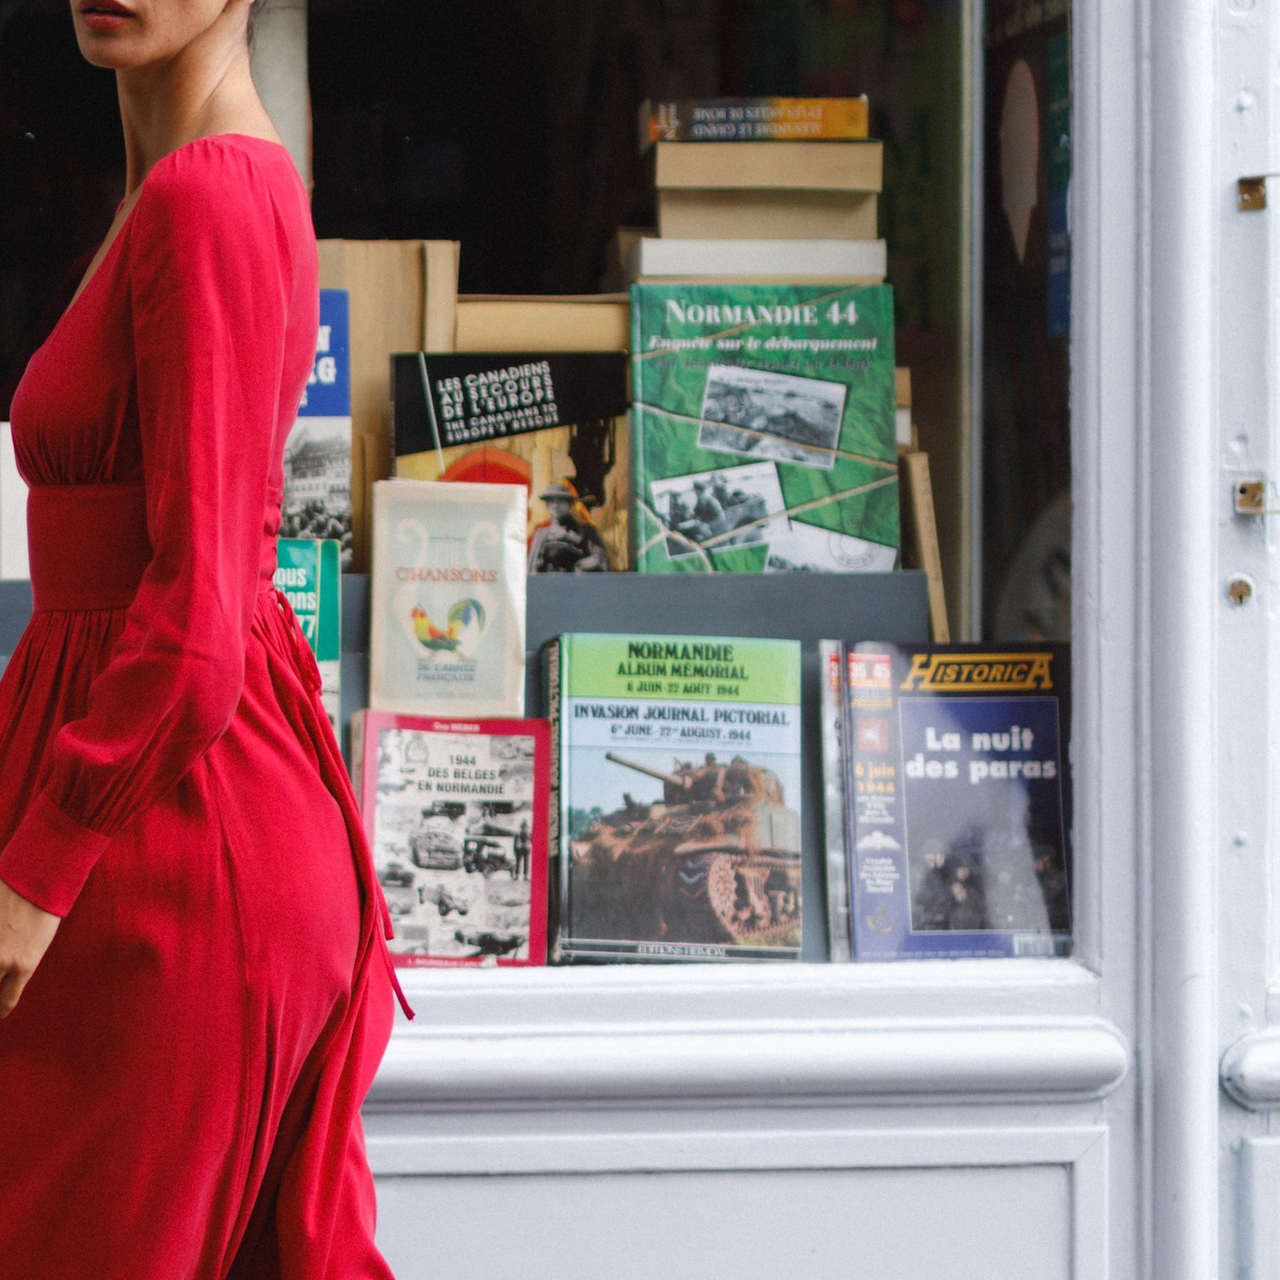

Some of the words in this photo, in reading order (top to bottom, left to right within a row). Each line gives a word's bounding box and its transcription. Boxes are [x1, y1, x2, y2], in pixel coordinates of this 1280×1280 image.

[665, 299, 818, 325] NORMANDIE
[825, 300, 859, 326] 44
[648, 335, 713, 352] Enquête
[717, 337, 743, 351] sur
[746, 336, 761, 350] le
[764, 335, 878, 355] débarquement
[438, 377, 461, 393] LES
[465, 360, 551, 387] CANADIENS
[440, 389, 464, 406] AU
[469, 373, 553, 401] SECOURS
[443, 404, 464, 420] DE
[471, 388, 555, 415] L'EUROPE
[444, 421, 465, 432] THE
[470, 407, 541, 427] CANADIANS
[542, 403, 558, 415] TO
[513, 413, 559, 431] RESCUE
[396, 565, 498, 584] CHANSONS
[628, 641, 734, 662] NORMANDIE
[617, 661, 667, 676] ALBUM
[899, 652, 1054, 692] HISTORICA
[637, 680, 662, 692] JUIN
[716, 684, 740, 696] 1944
[574, 703, 639, 719] INVASION
[643, 705, 709, 722] JOURNAL
[714, 707, 791, 725] PICTORIAL
[624, 724, 653, 736] JUNE
[728, 729, 752, 741] 1944
[925, 725, 961, 751] La
[972, 724, 1034, 752] nuit
[449, 754, 476, 766] 1944
[867, 761, 896, 779] juin
[905, 753, 959, 780] des
[969, 759, 1057, 785] paras
[428, 766, 450, 779] DES
[453, 767, 497, 781] BELGES
[417, 780, 433, 792] EN
[436, 781, 505, 795] NORMANDIE
